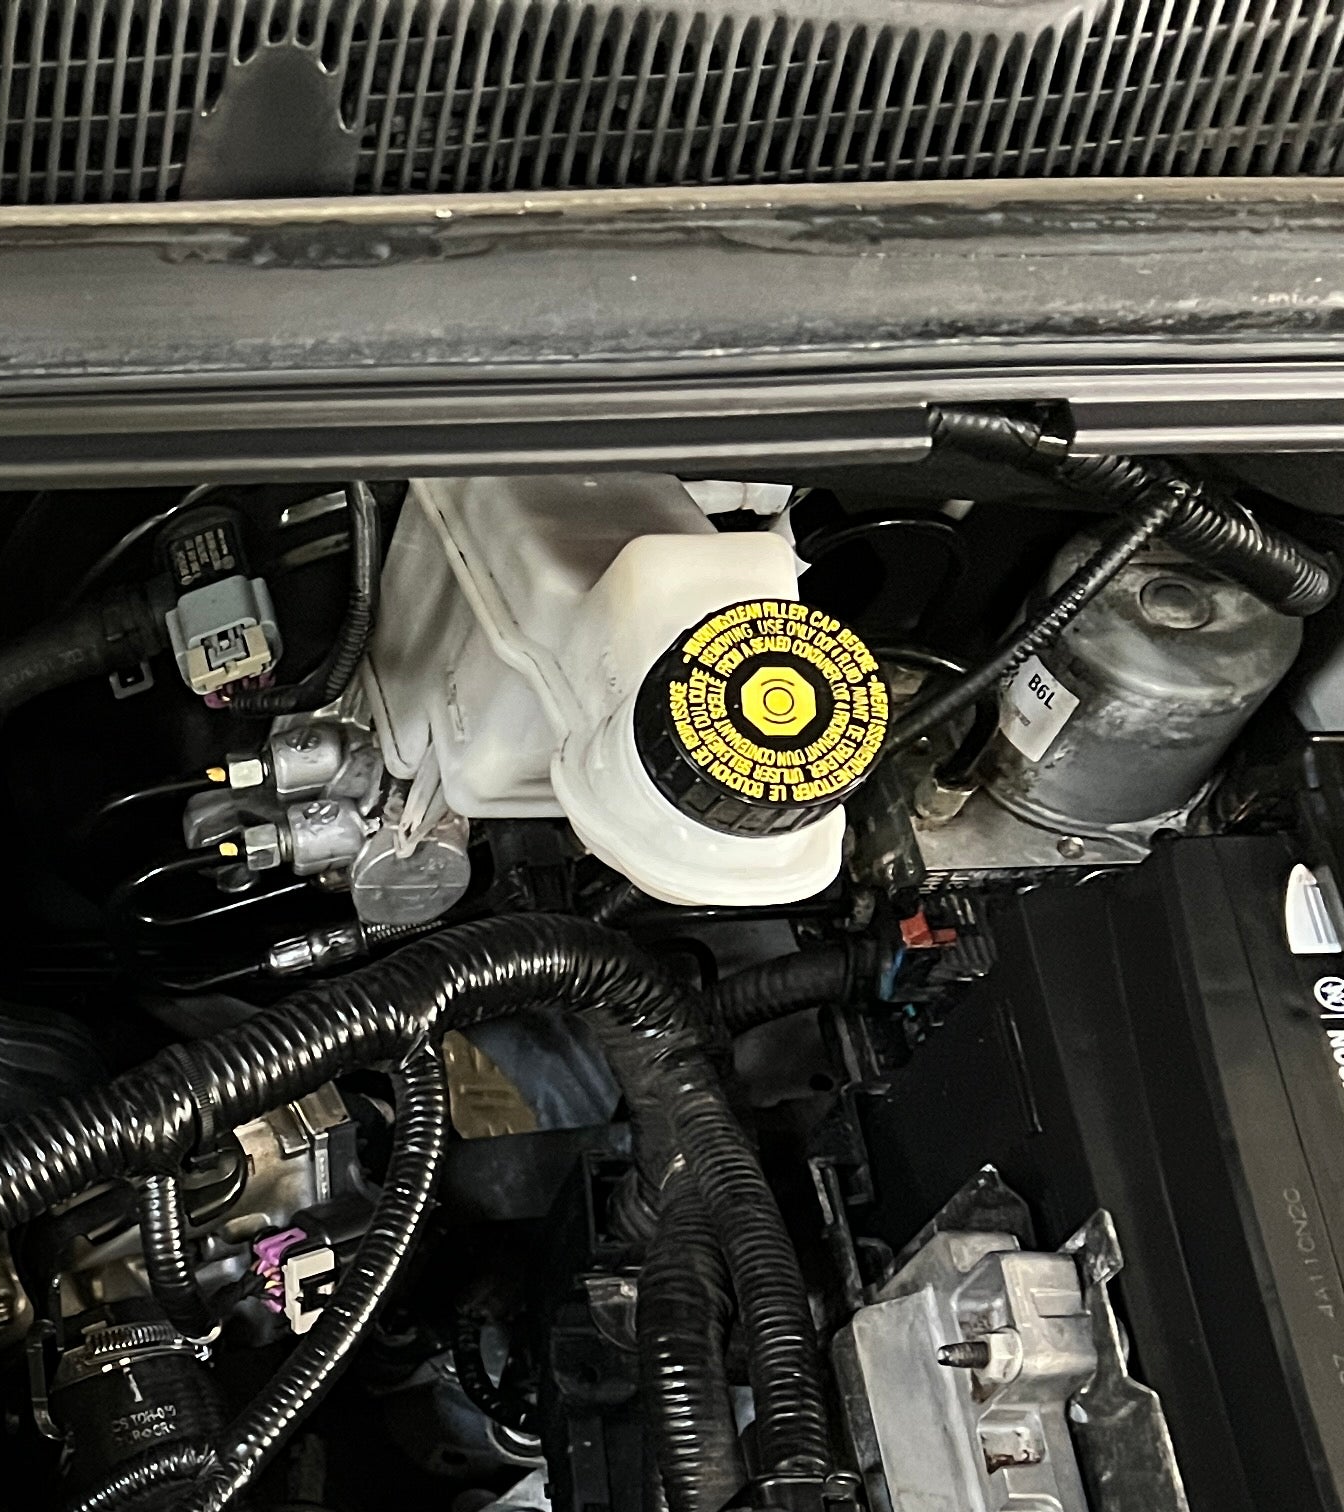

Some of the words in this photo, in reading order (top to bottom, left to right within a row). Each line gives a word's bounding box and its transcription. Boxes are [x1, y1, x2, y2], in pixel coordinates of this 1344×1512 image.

[756, 618, 785, 635] USE
[786, 620, 817, 641] ONLY
[762, 601, 809, 622] FILLER
[809, 610, 841, 633] CAP
[835, 628, 879, 674] BEFORE
[740, 642, 754, 659] A
[749, 635, 792, 655] SEALED
[768, 784, 787, 802] LE
